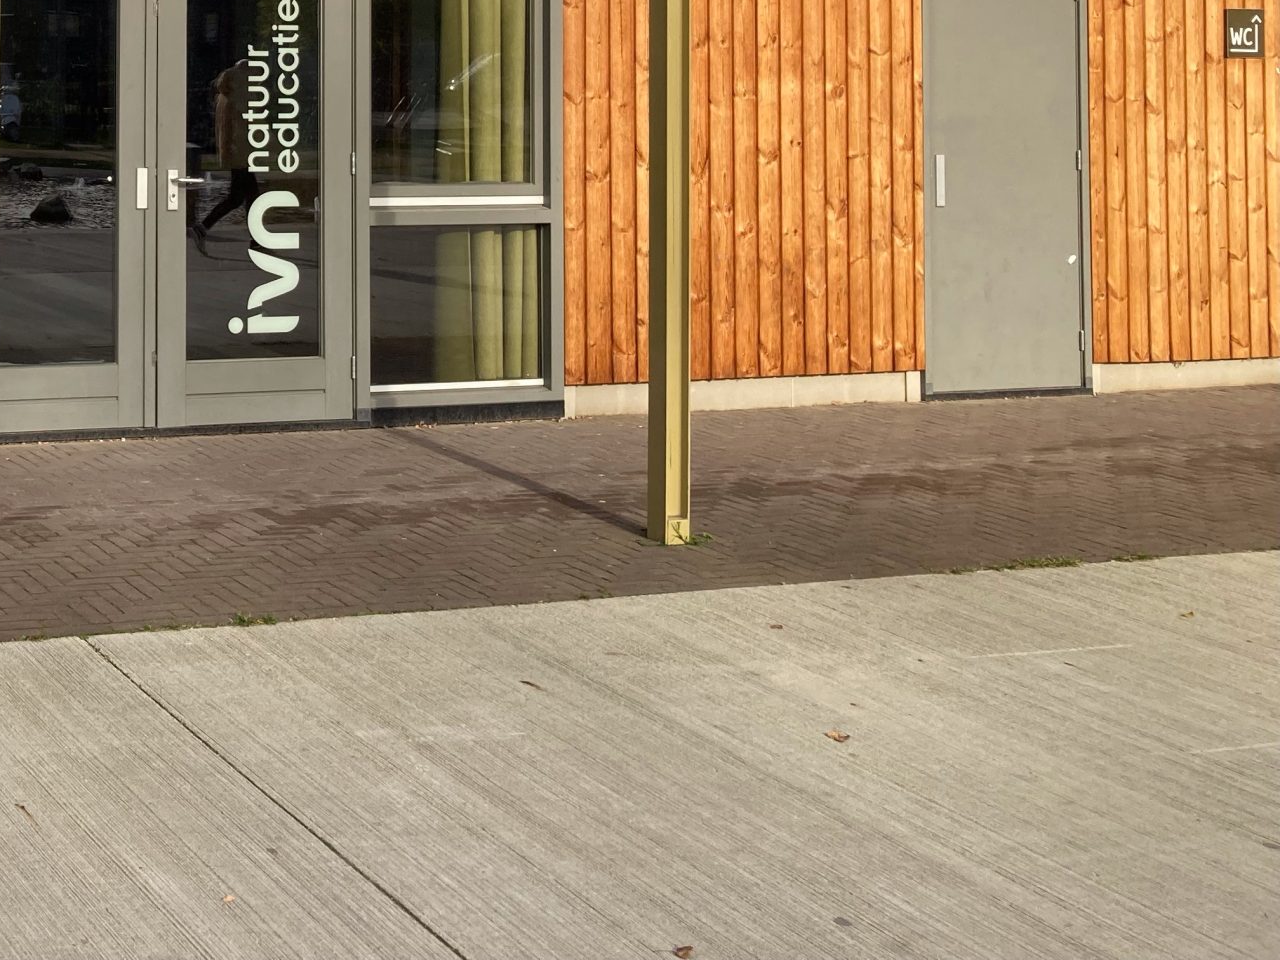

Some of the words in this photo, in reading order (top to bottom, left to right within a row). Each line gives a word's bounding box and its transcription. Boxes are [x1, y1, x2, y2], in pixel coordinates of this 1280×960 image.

[1229, 27, 1254, 46] WC
[242, 44, 270, 173] natuur
[227, 190, 300, 334] ivn
